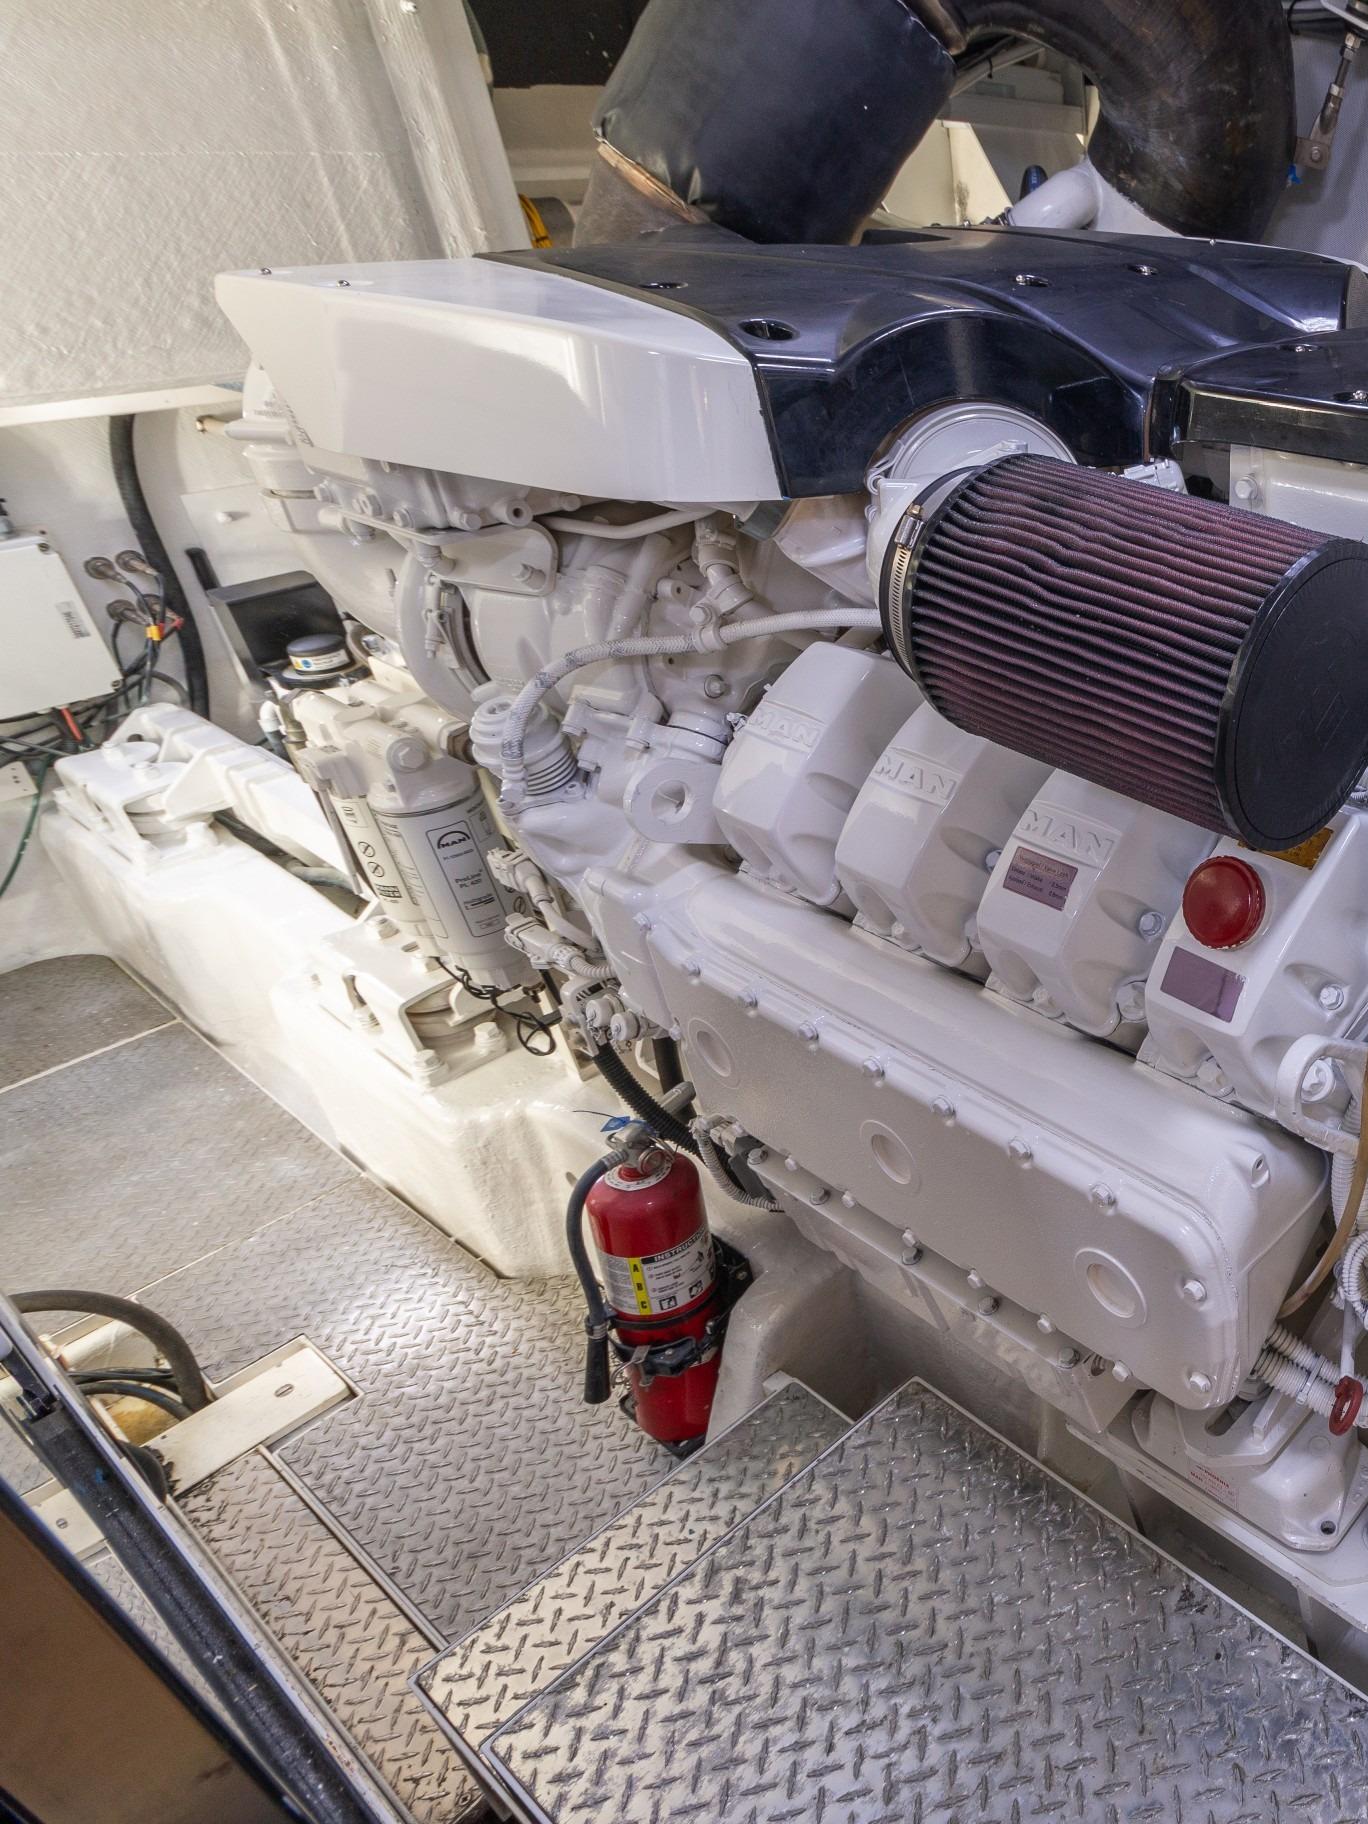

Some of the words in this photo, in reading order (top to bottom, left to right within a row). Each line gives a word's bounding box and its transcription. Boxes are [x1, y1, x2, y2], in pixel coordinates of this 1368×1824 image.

[746, 709, 822, 749] MAN
[872, 757, 958, 800] MAN
[1020, 807, 1116, 859] MAN
[440, 836, 467, 848] MAN
[632, 1264, 640, 1273] A
[636, 1282, 644, 1292] B
[640, 1301, 648, 1309] C
